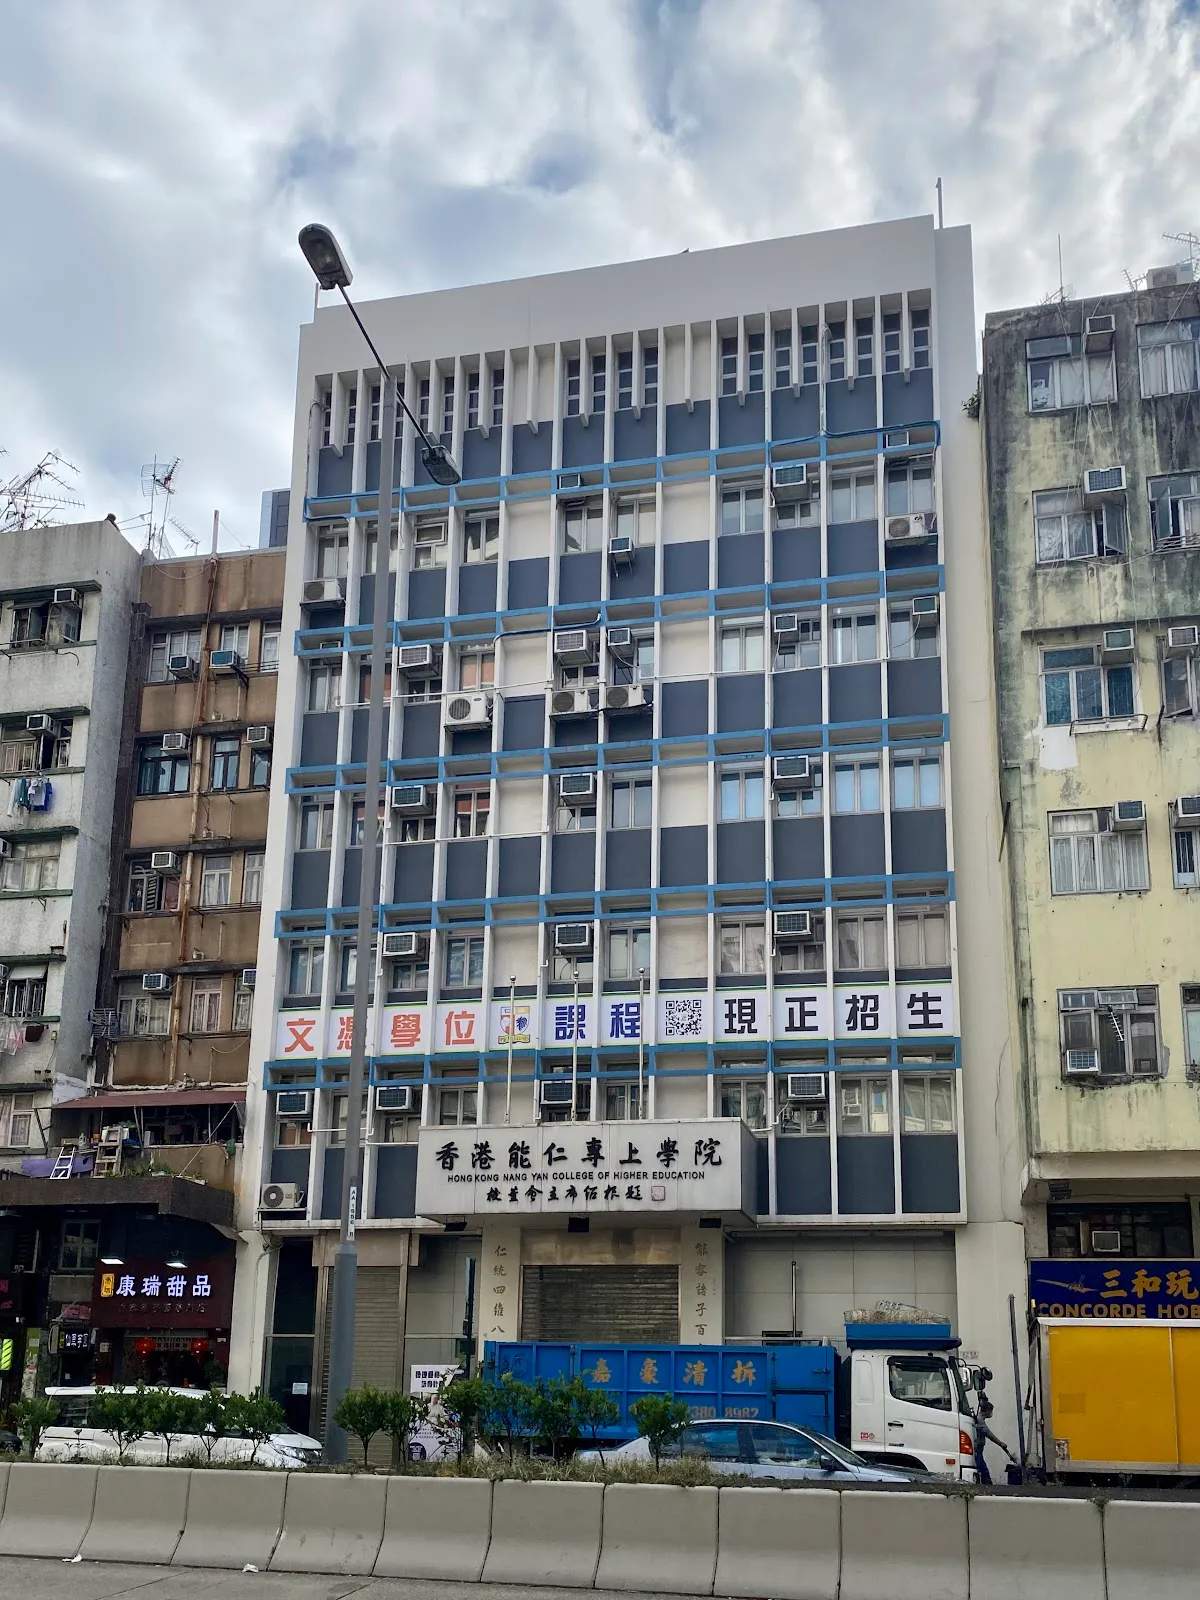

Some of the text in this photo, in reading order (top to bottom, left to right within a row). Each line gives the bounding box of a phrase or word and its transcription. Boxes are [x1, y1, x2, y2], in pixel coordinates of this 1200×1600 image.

[724, 991, 944, 1034] 現正招生
[435, 1136, 723, 1171] 香港能仁專上學院
[447, 1171, 705, 1183] HONG KONG NANG YAN COLLEGE OF HIGHER EDUCATION
[115, 1274, 212, 1297] 康瑞甜品
[1100, 1268, 1200, 1300] 三和玩
[1038, 1303, 1147, 1318] CONCORDE
